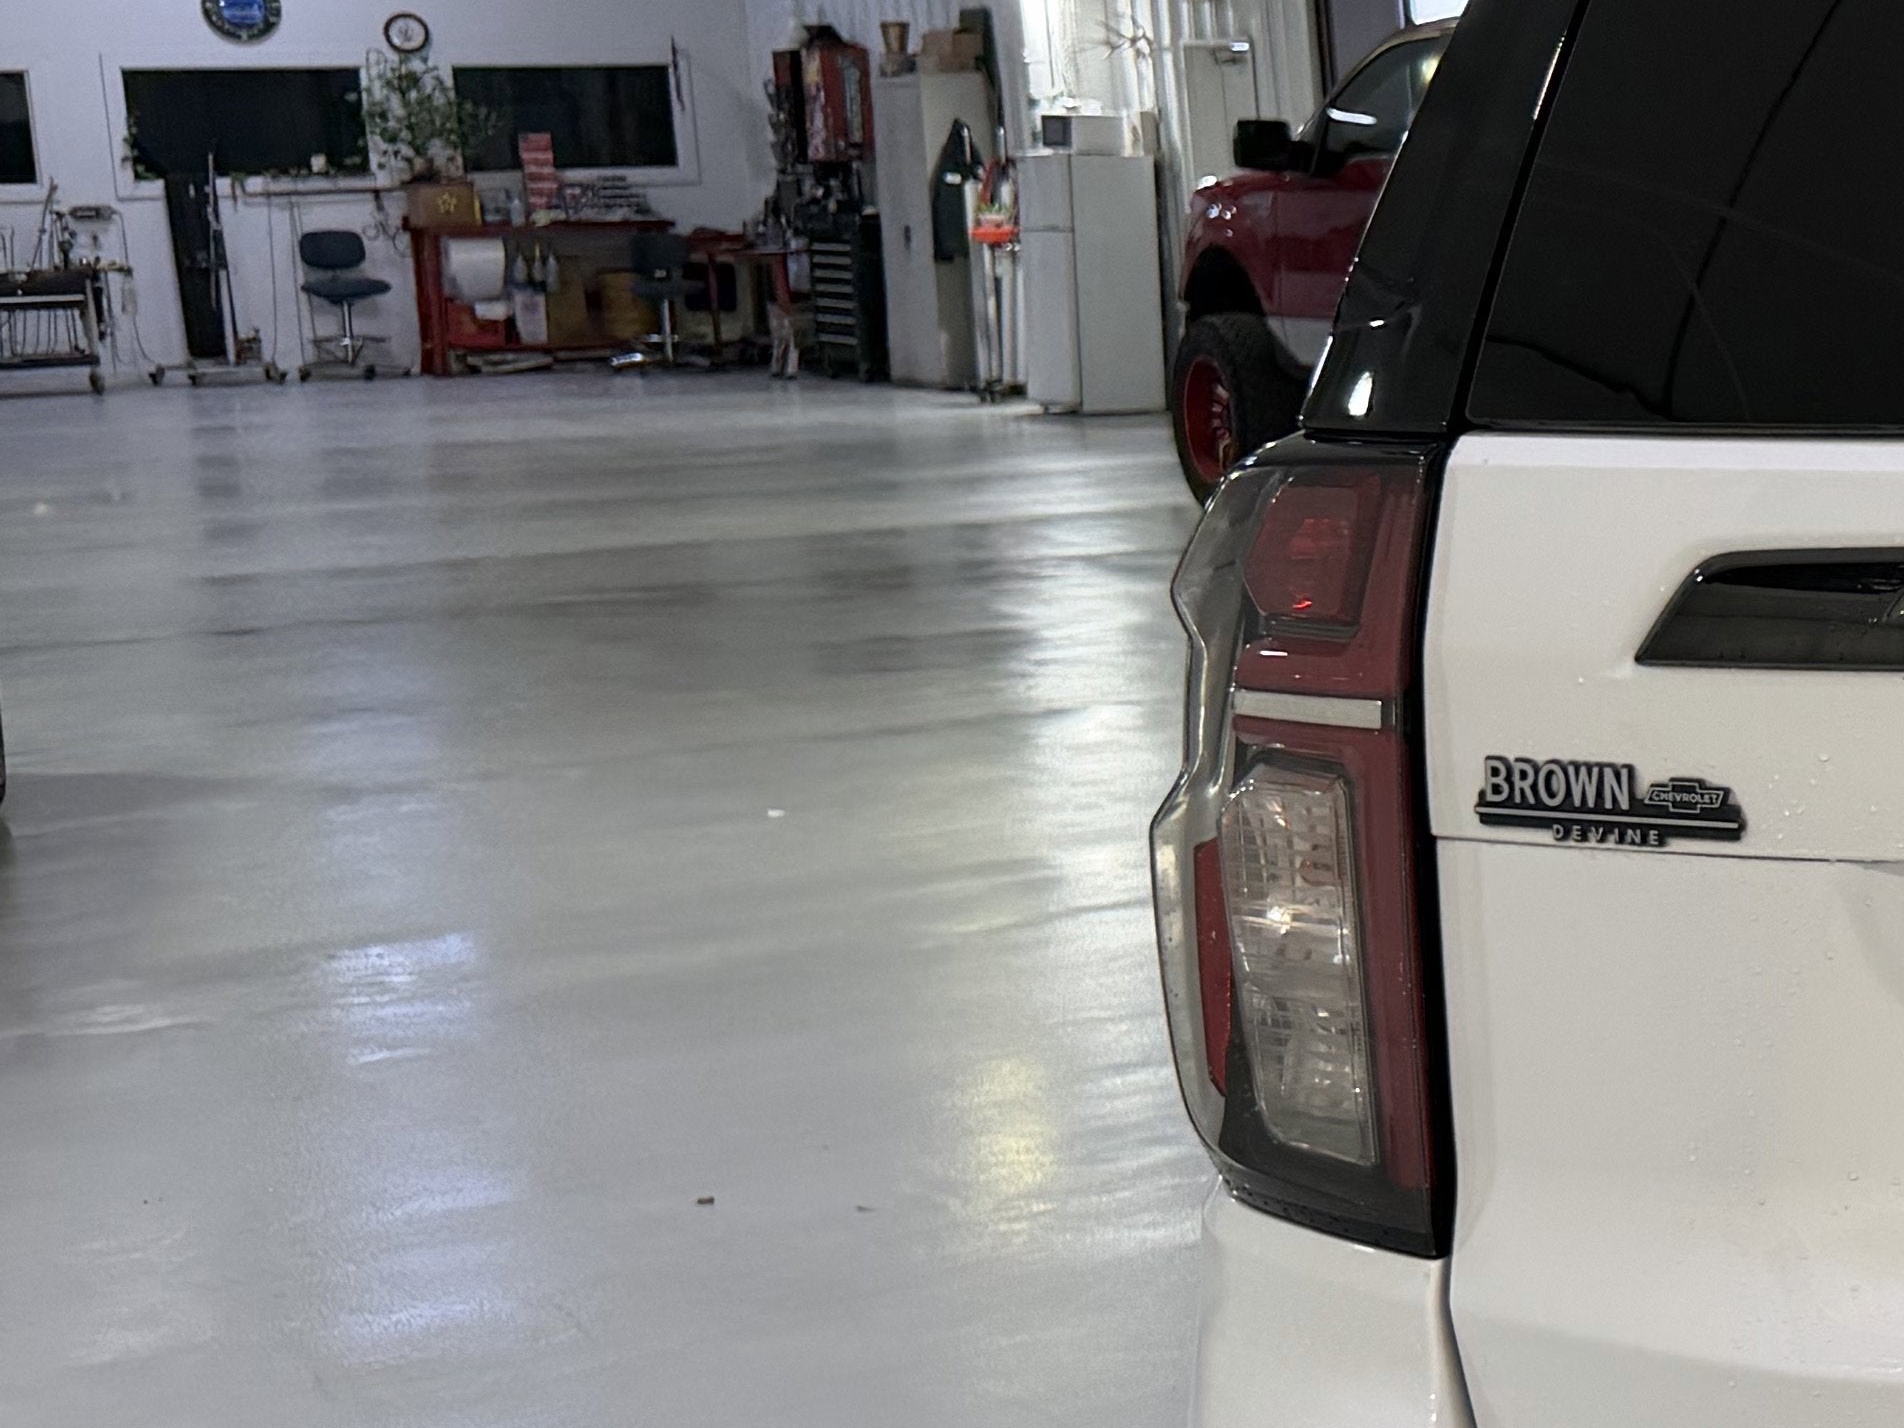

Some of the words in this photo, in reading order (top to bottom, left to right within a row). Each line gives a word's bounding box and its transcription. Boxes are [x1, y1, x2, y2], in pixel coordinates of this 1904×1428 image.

[1484, 756, 1632, 811] BROWN
[1651, 790, 1719, 805] CHEVROLET
[1553, 825, 1660, 845] DEVINE
